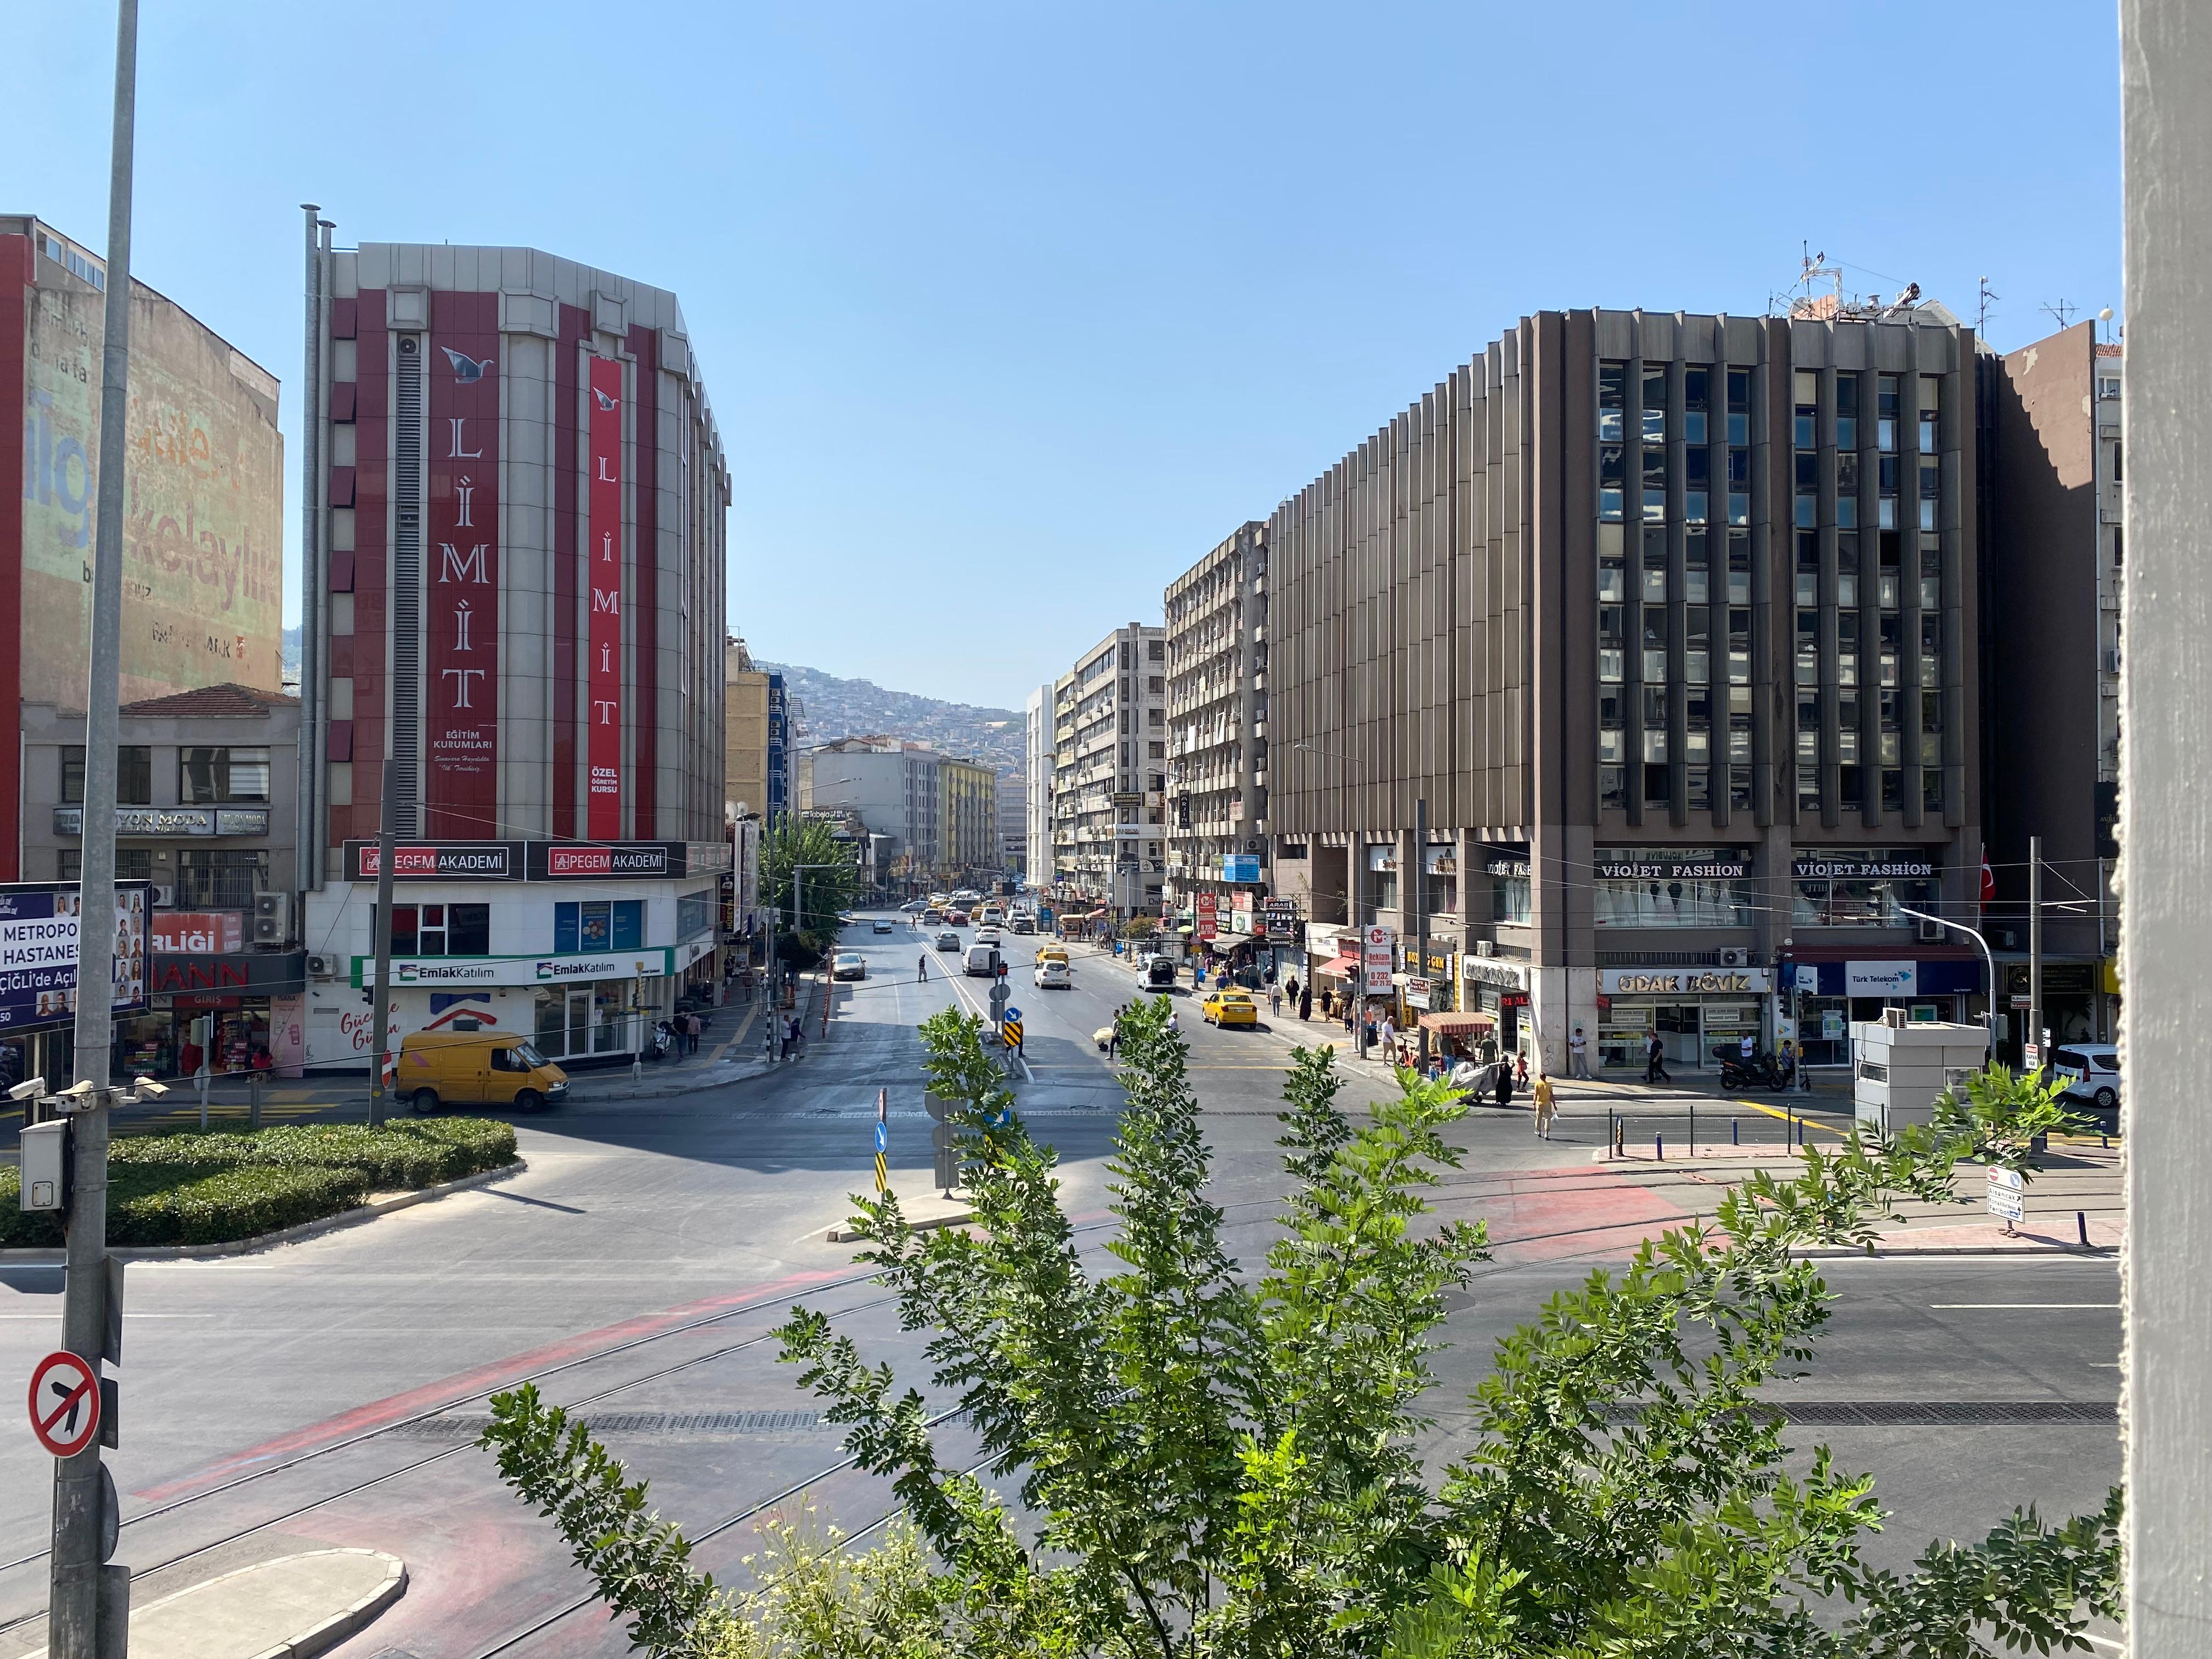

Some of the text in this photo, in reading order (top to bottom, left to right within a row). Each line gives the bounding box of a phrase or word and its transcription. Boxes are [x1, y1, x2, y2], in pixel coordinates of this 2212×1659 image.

[437, 417, 491, 709] LİMİT
[592, 456, 619, 725] LİMİT
[445, 729, 479, 740] EĞİTİM
[433, 740, 492, 749] KURUMLARI
[591, 766, 617, 778] ÖZEL
[591, 785, 617, 793] KURSU
[116, 814, 207, 826] YON MODA
[809, 810, 830, 818] Tabela
[394, 855, 435, 869] EGEM
[437, 851, 503, 869] AKADEMİ
[569, 854, 610, 868] PEGEM
[612, 851, 663, 868] AKADEMİ
[1672, 862, 1743, 877] FASHİON
[1860, 861, 1932, 876] FASHİON
[4, 923, 77, 942] METROPO
[554, 962, 615, 976] EmlakKatılım
[1431, 956, 1444, 969] GSM
[153, 962, 249, 990] ANN
[419, 966, 494, 979] EmlakKatılım
[1376, 972, 1389, 980] 232
[1619, 971, 1752, 991] ODAK DÖVİZ
[1989, 1188, 2016, 1201] Alsancak
[1989, 1198, 2002, 1206] Konak
[1989, 1204, 2010, 1216] Feribot
